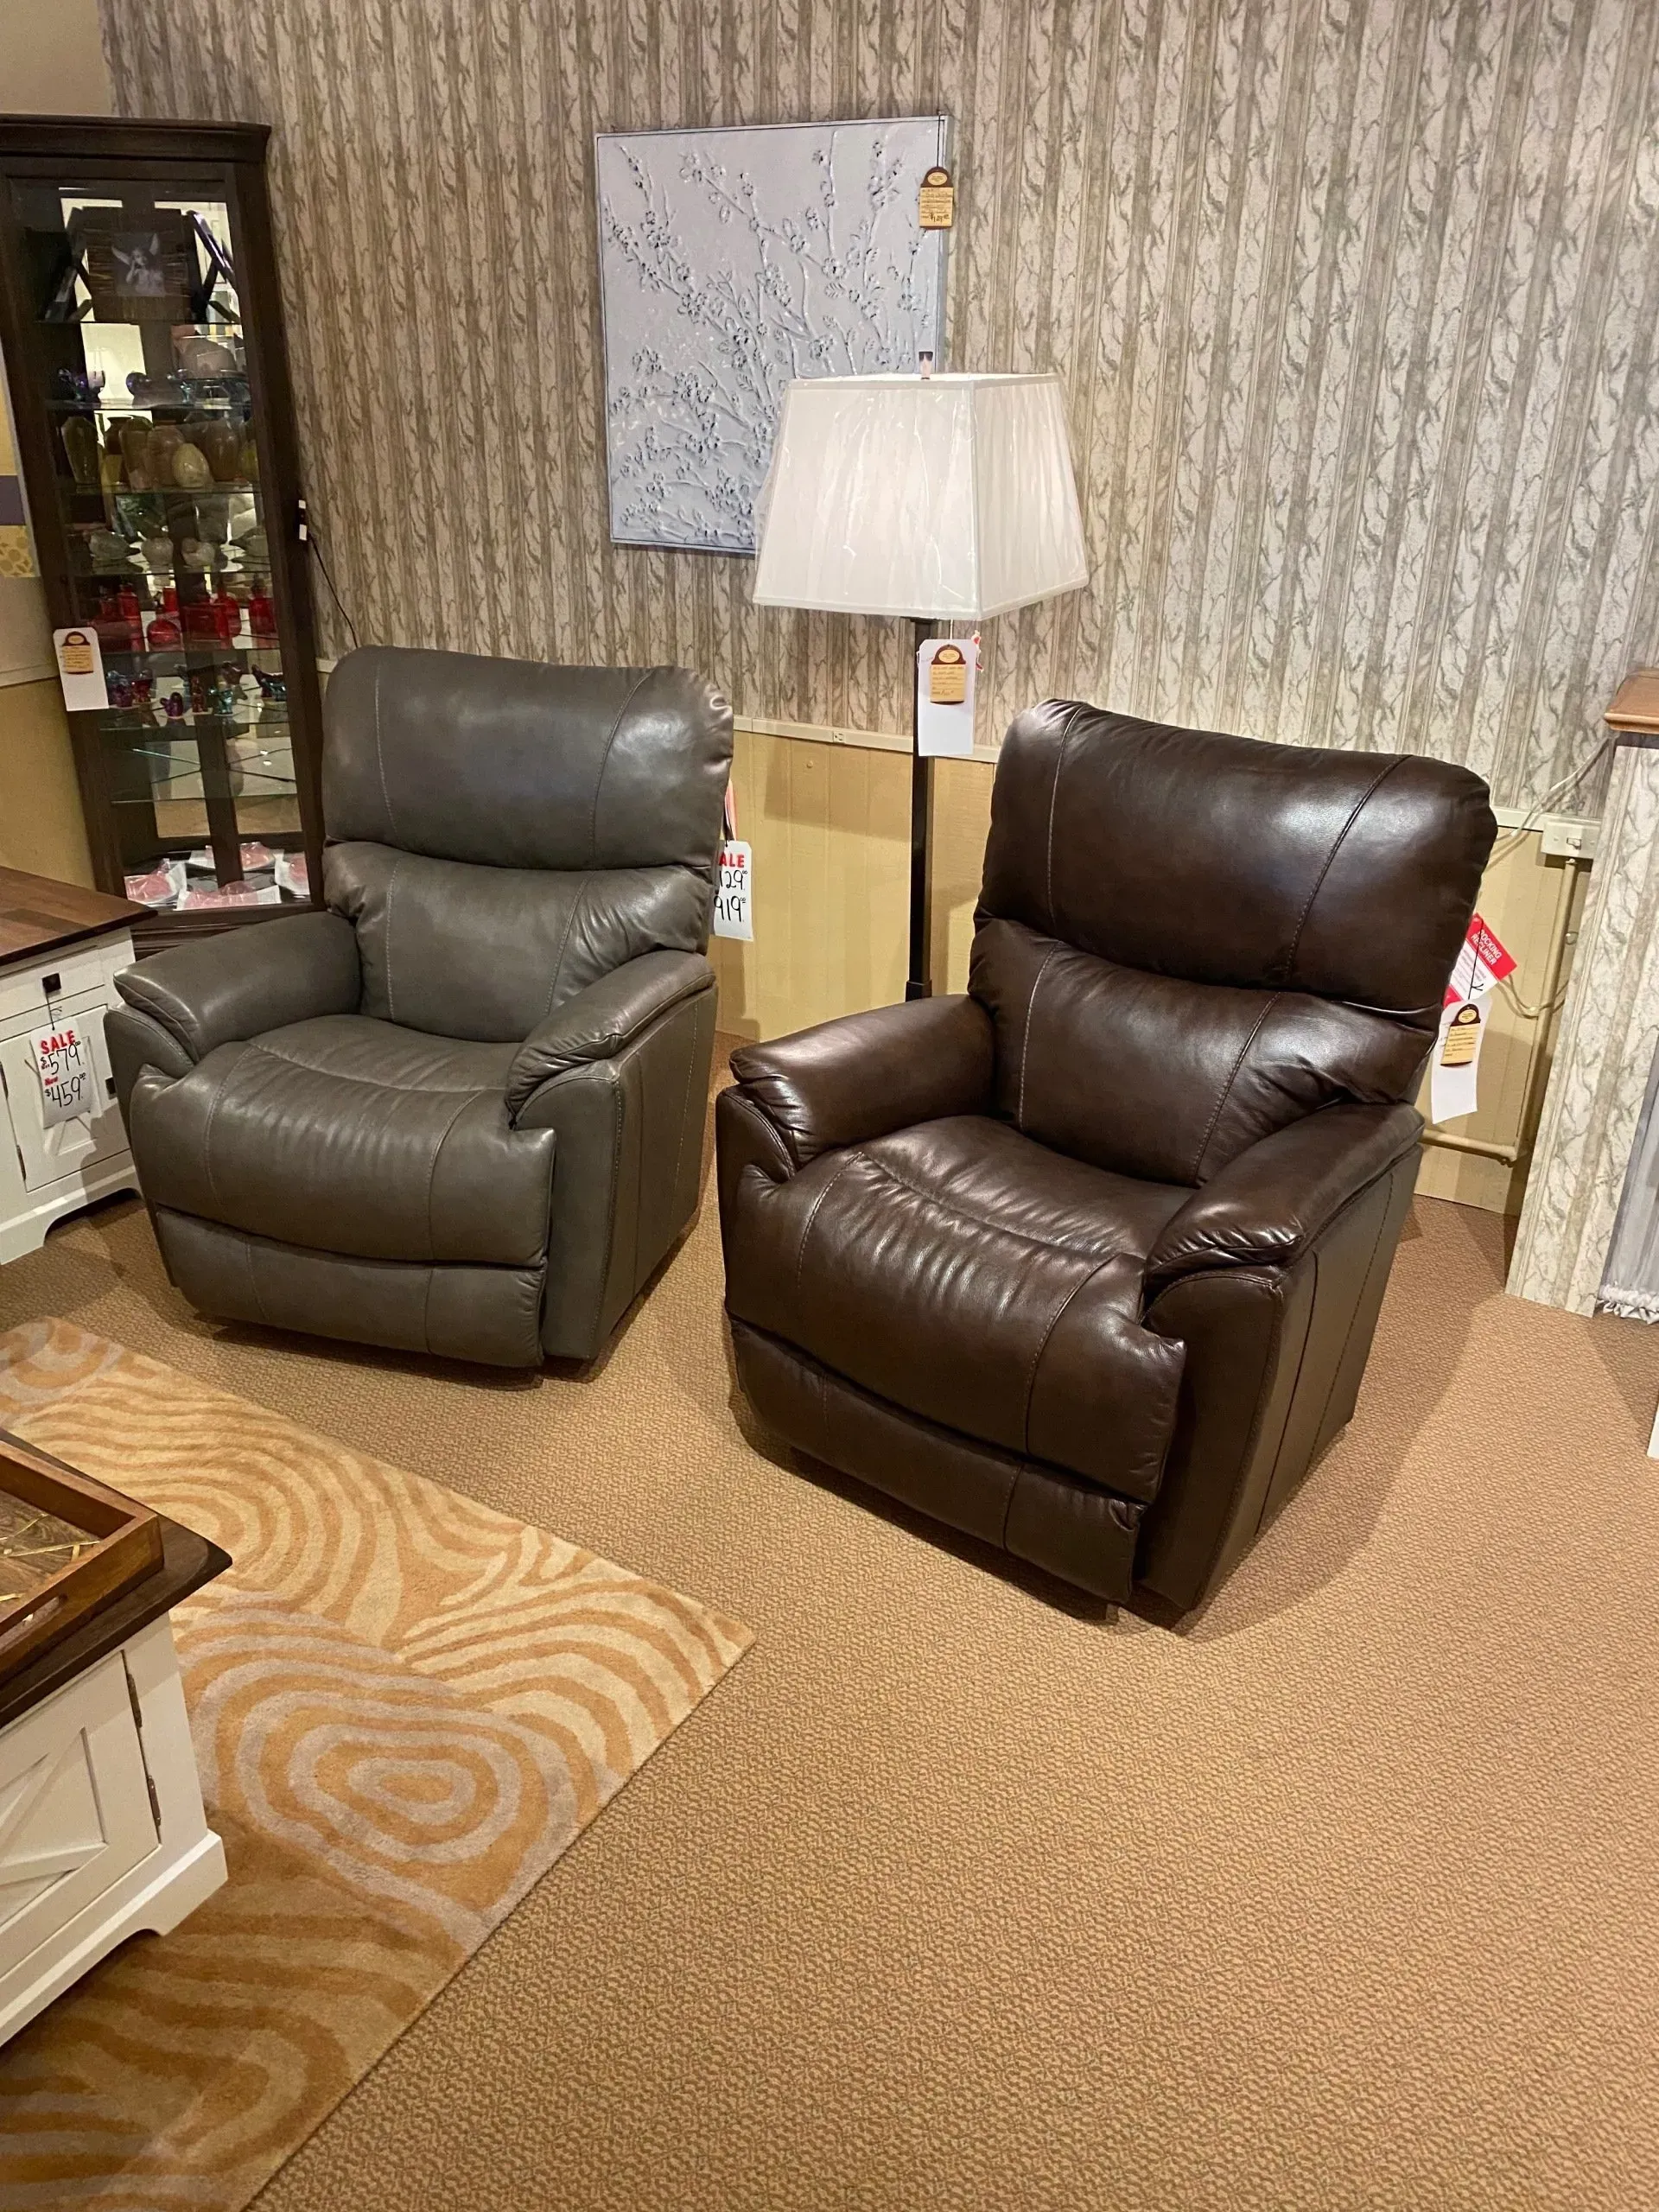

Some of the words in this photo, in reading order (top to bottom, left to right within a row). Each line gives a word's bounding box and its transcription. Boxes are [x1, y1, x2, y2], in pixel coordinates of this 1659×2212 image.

[1471, 932, 1497, 966] RECLINER
[1477, 929, 1503, 960] ROCKING
[41, 1029, 76, 1055] SALE
